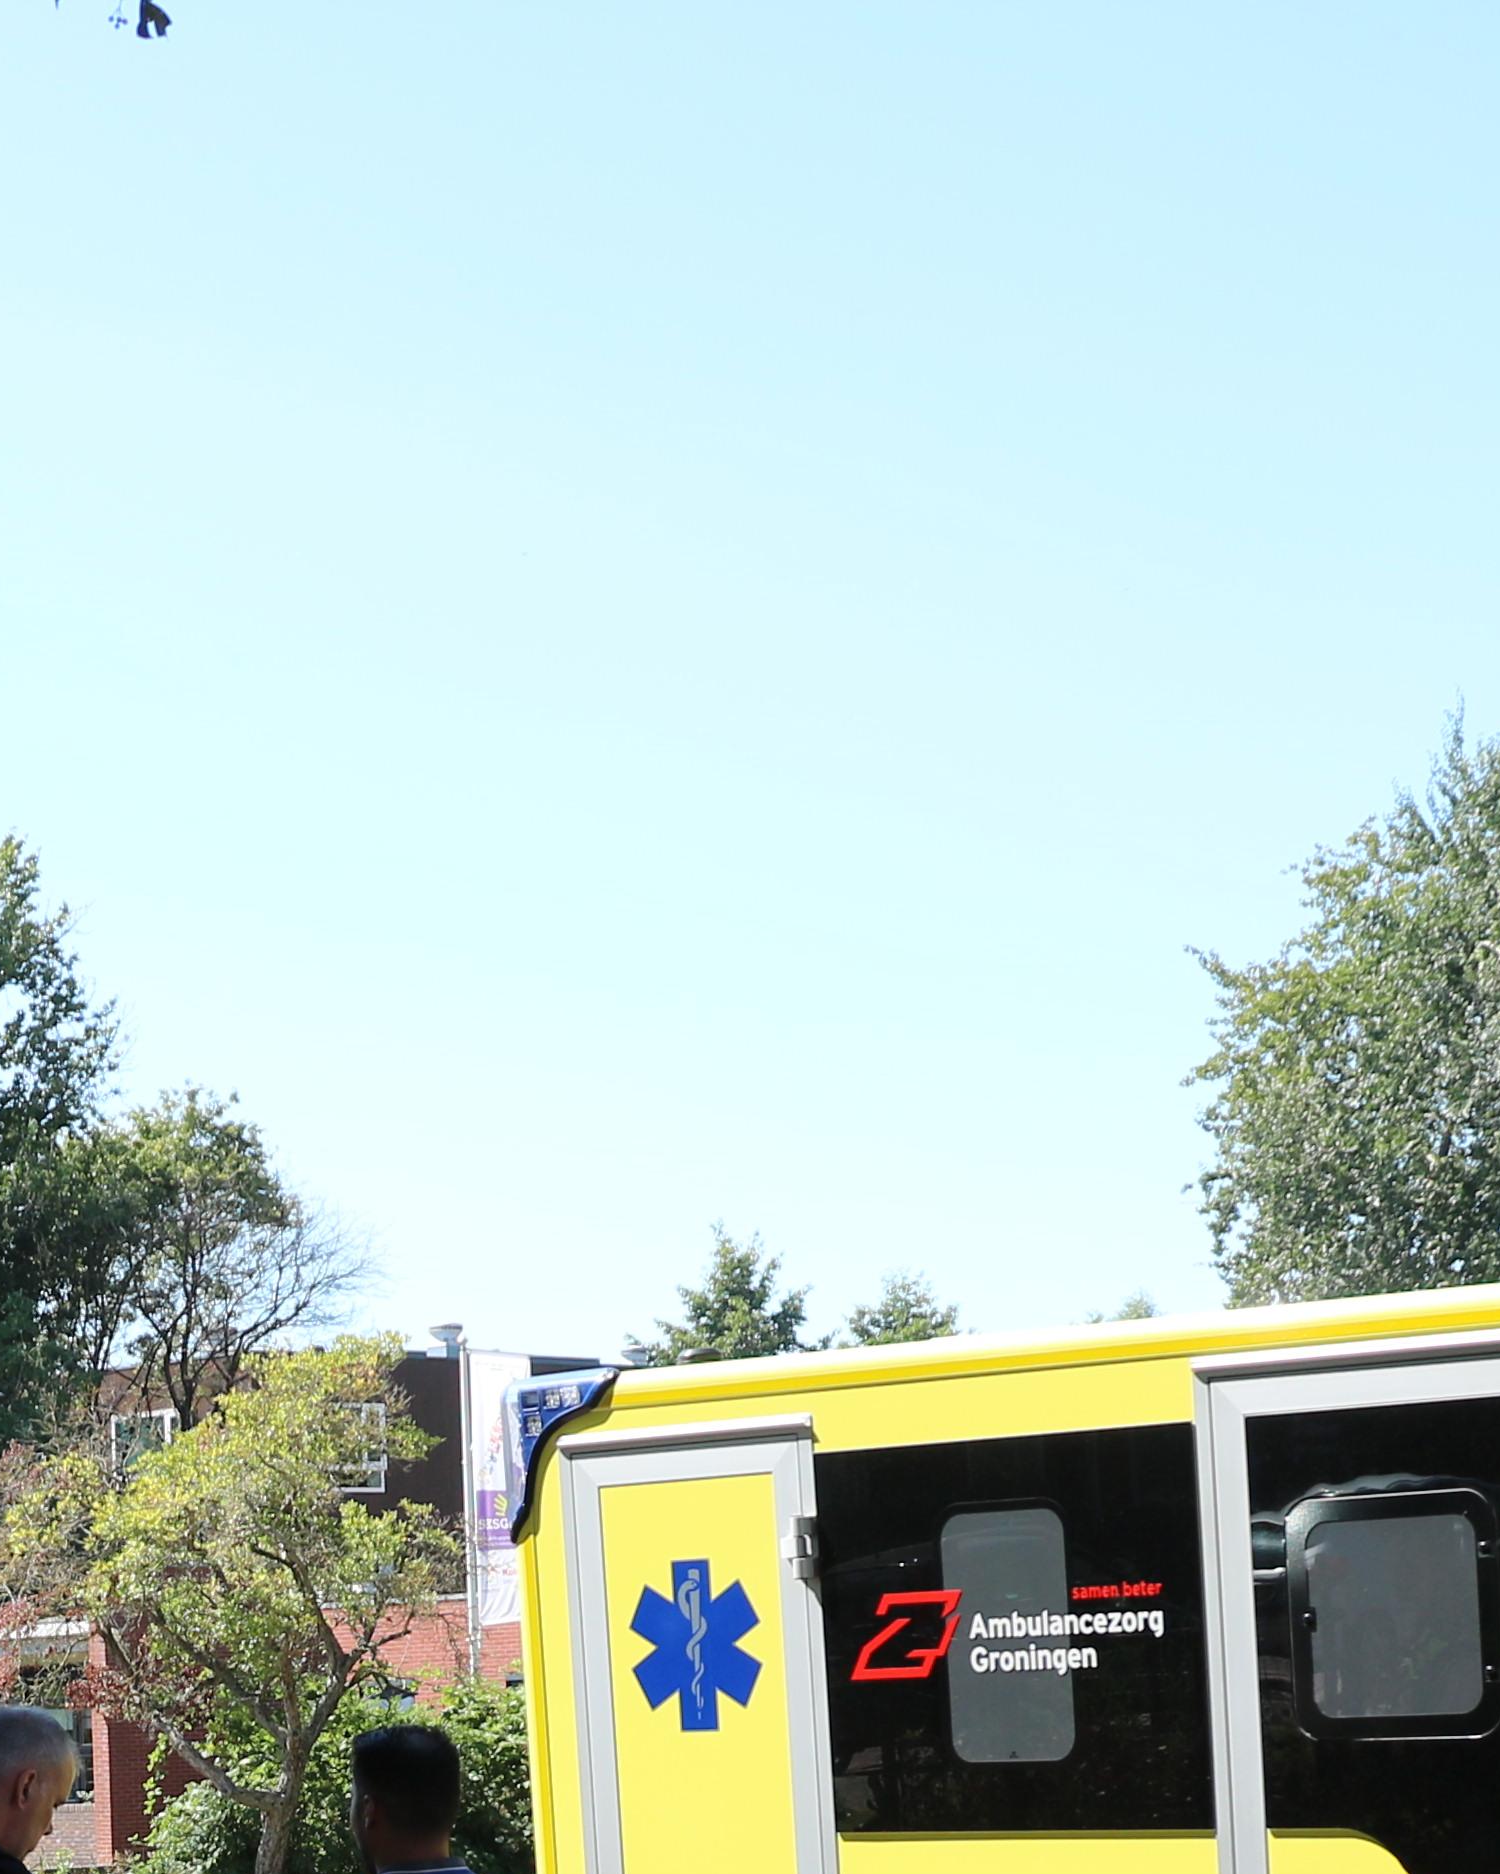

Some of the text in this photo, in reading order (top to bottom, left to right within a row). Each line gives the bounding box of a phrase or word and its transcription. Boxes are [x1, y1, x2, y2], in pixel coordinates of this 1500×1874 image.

[1071, 1579, 1163, 1600] samen beter
[969, 1608, 1165, 1639] Ambulancezorg
[969, 1643, 1098, 1674] Groningen
